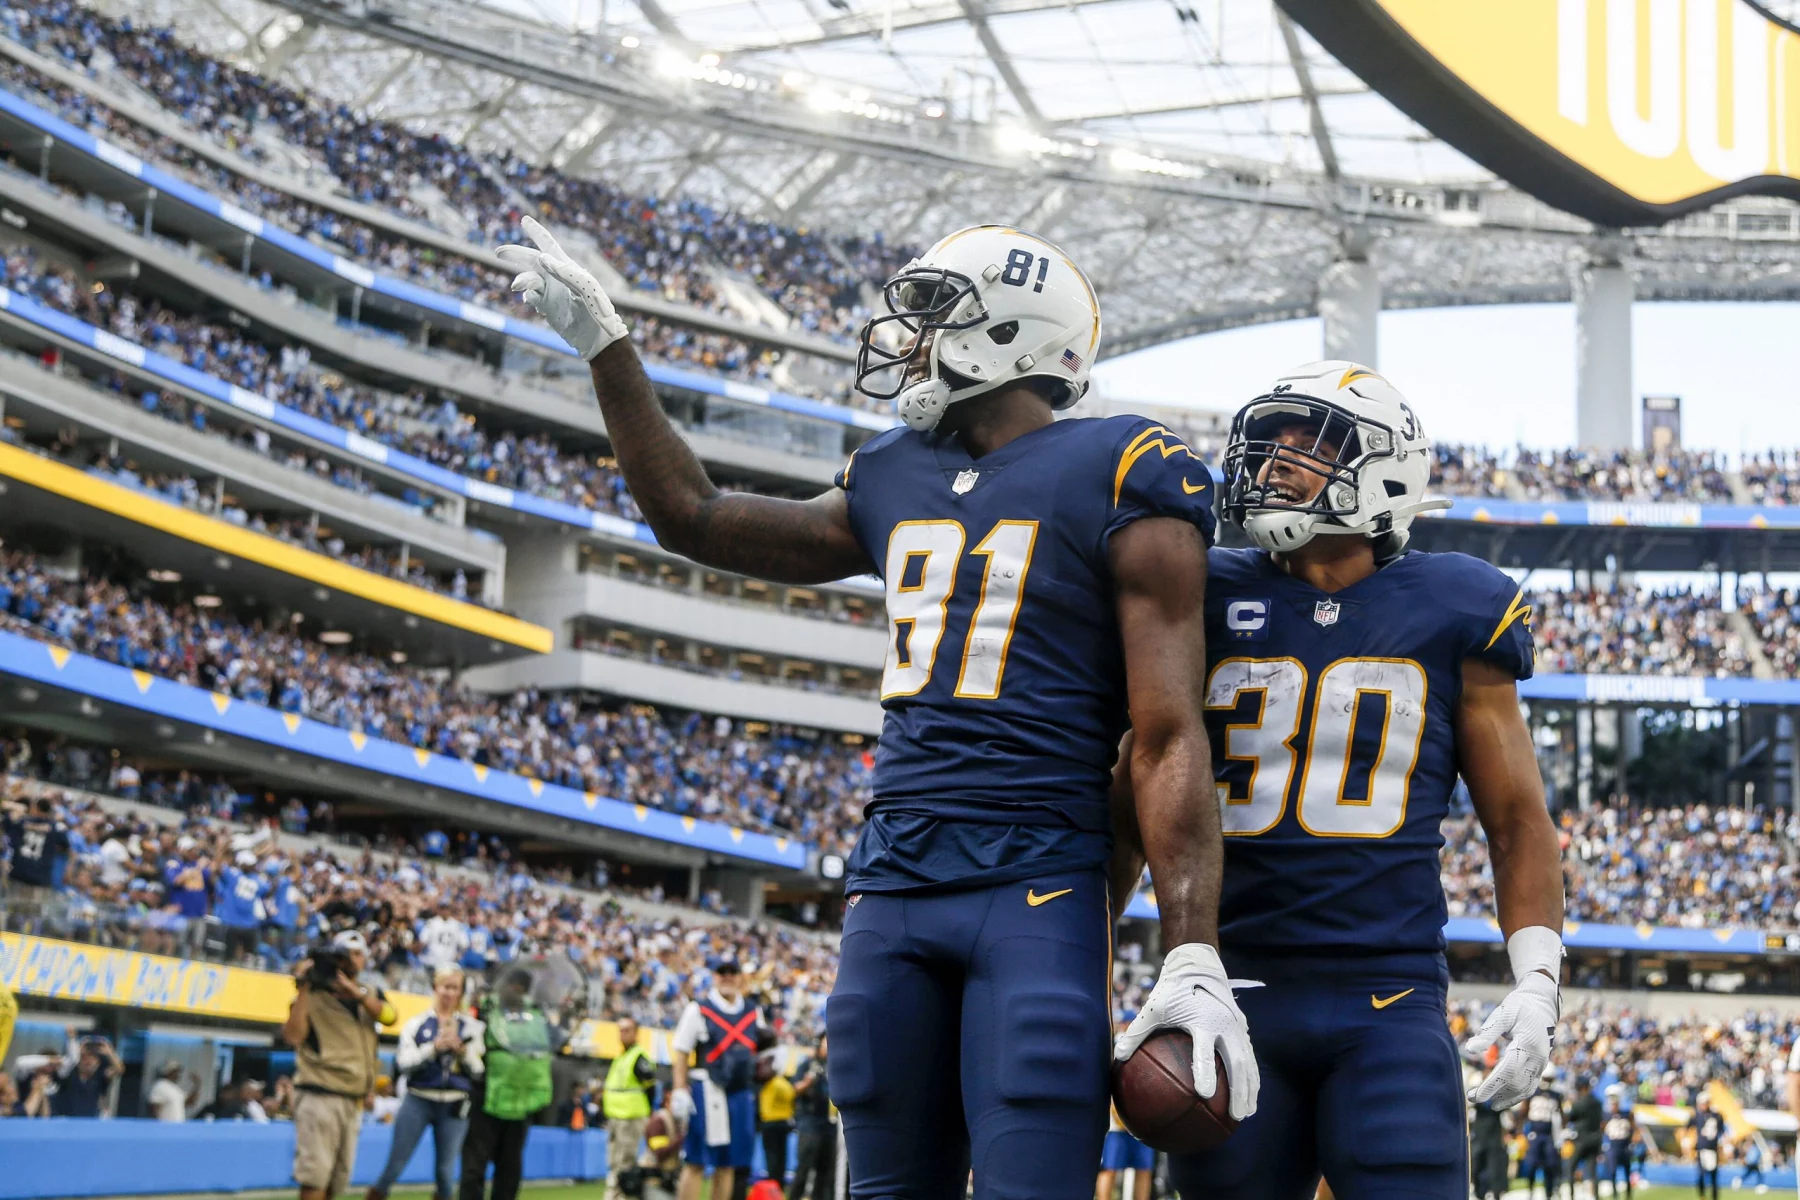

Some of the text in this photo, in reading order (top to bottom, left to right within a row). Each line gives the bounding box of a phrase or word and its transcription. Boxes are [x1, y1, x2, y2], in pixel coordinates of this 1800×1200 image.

[1001, 248, 1050, 294] 81
[880, 518, 1040, 701] 81
[1226, 601, 1266, 630] C
[1203, 656, 1428, 838] 30
